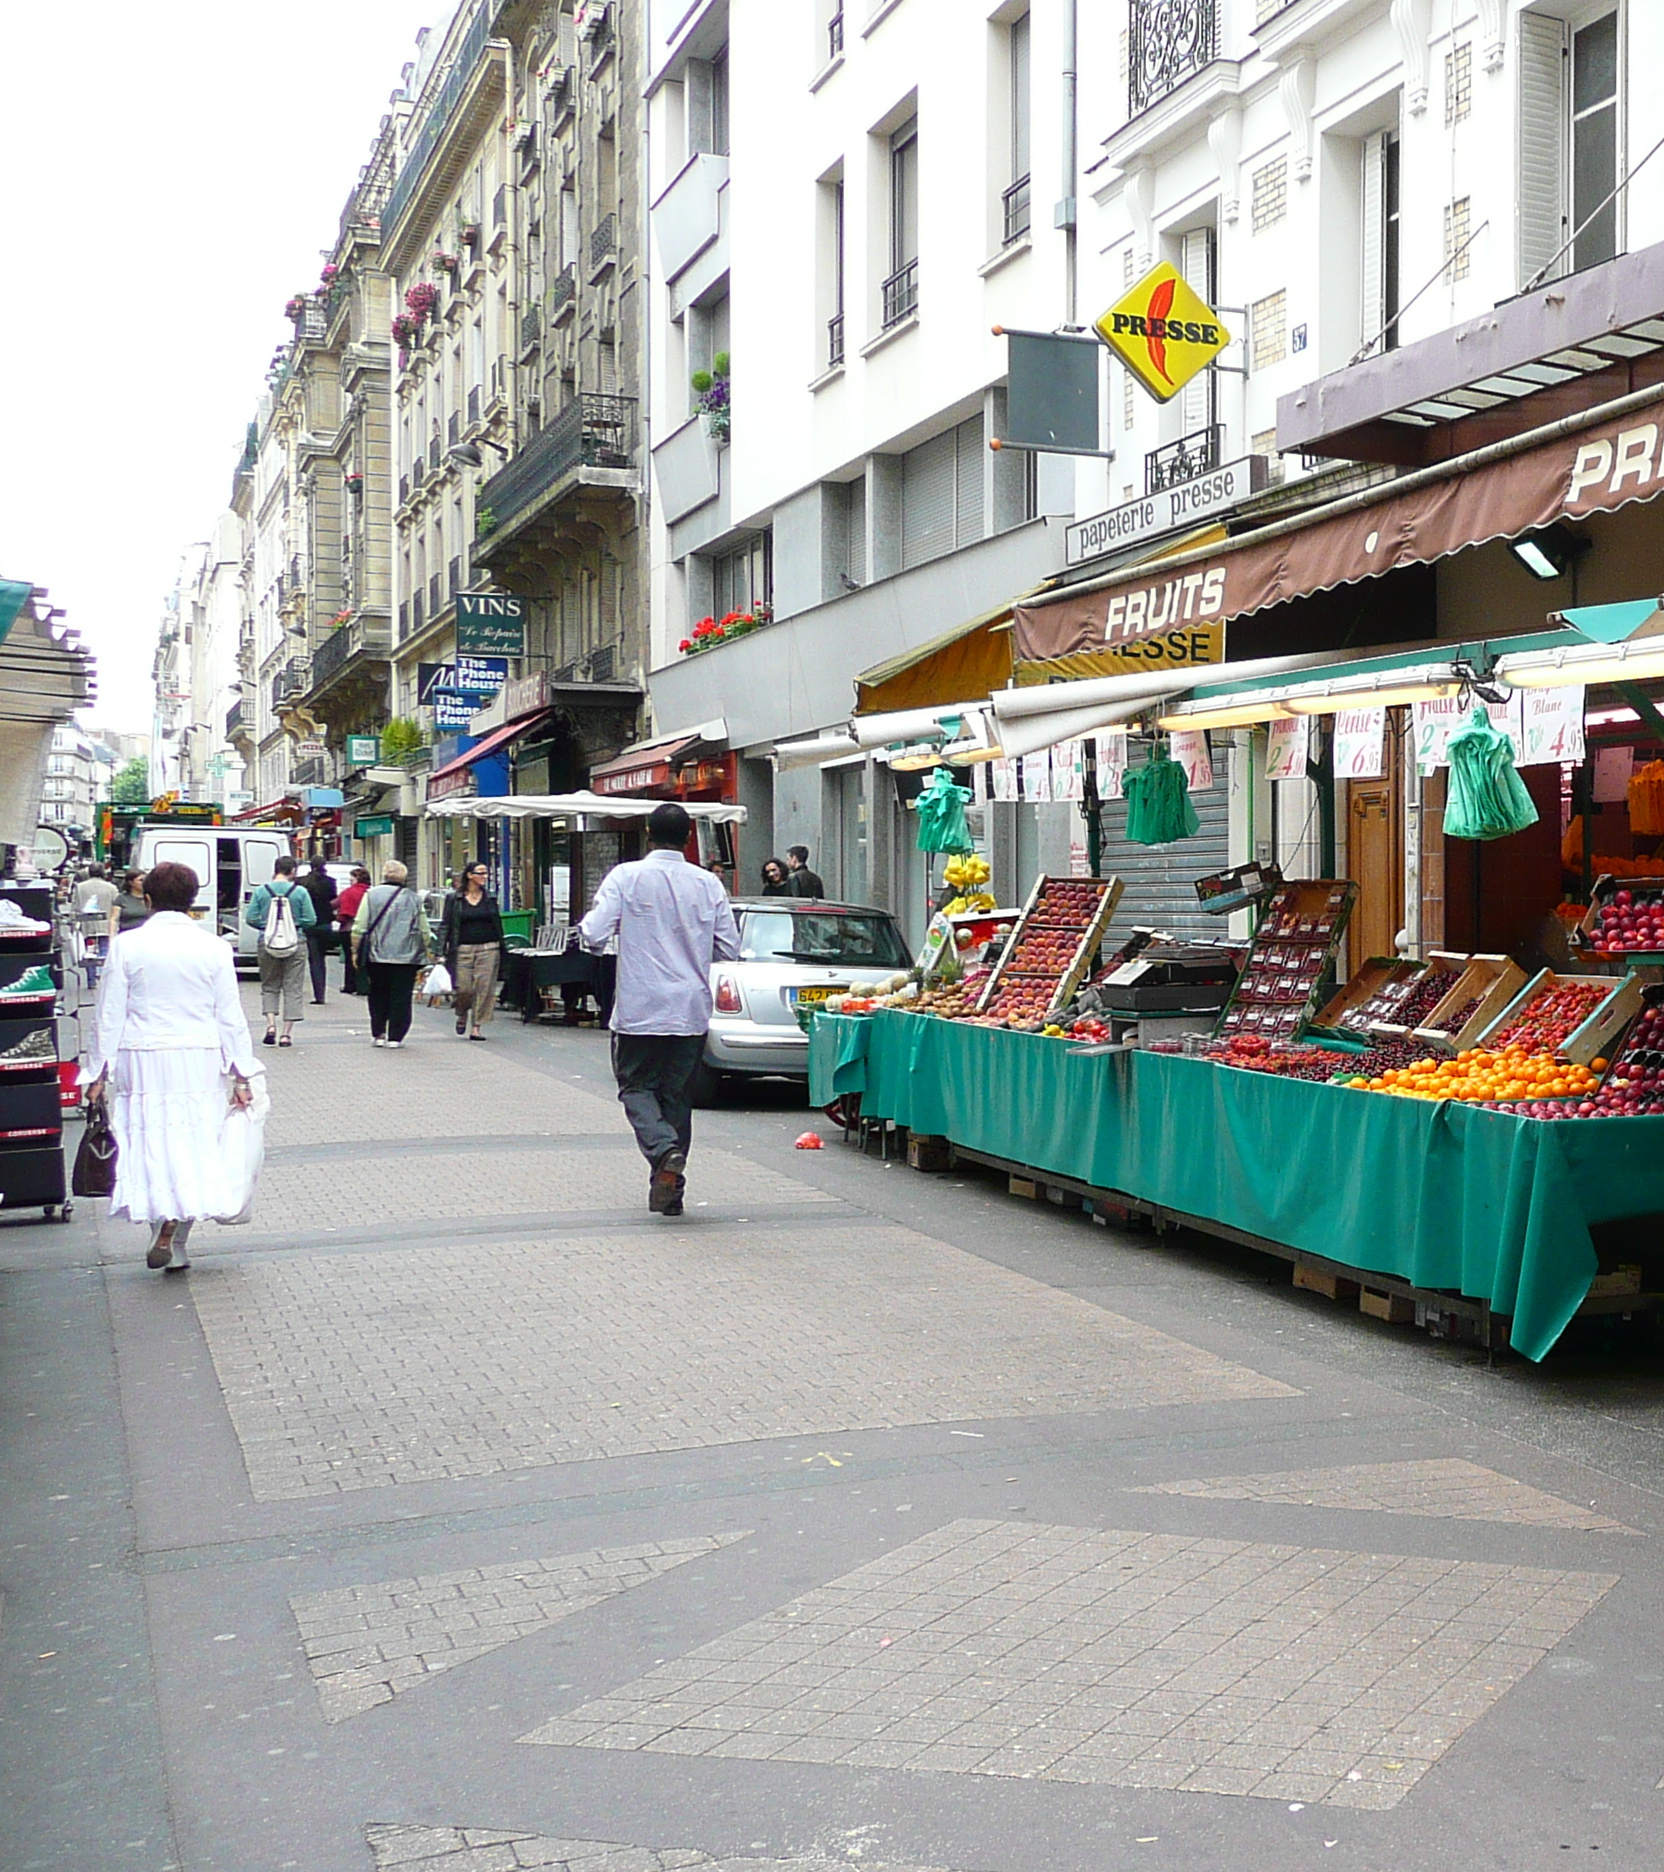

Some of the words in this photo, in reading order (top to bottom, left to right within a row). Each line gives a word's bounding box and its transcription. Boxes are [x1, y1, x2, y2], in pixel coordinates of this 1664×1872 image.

[1111, 312, 1220, 346] PRESSE
[1293, 327, 1305, 351] 57
[1079, 500, 1155, 559] papeterie
[1169, 470, 1235, 526] presse
[461, 596, 521, 617] VINS
[1103, 566, 1227, 641] FRUITS
[458, 657, 488, 669] The
[458, 667, 505, 680] Phone
[436, 694, 464, 705] The
[799, 990, 823, 1002] 642
